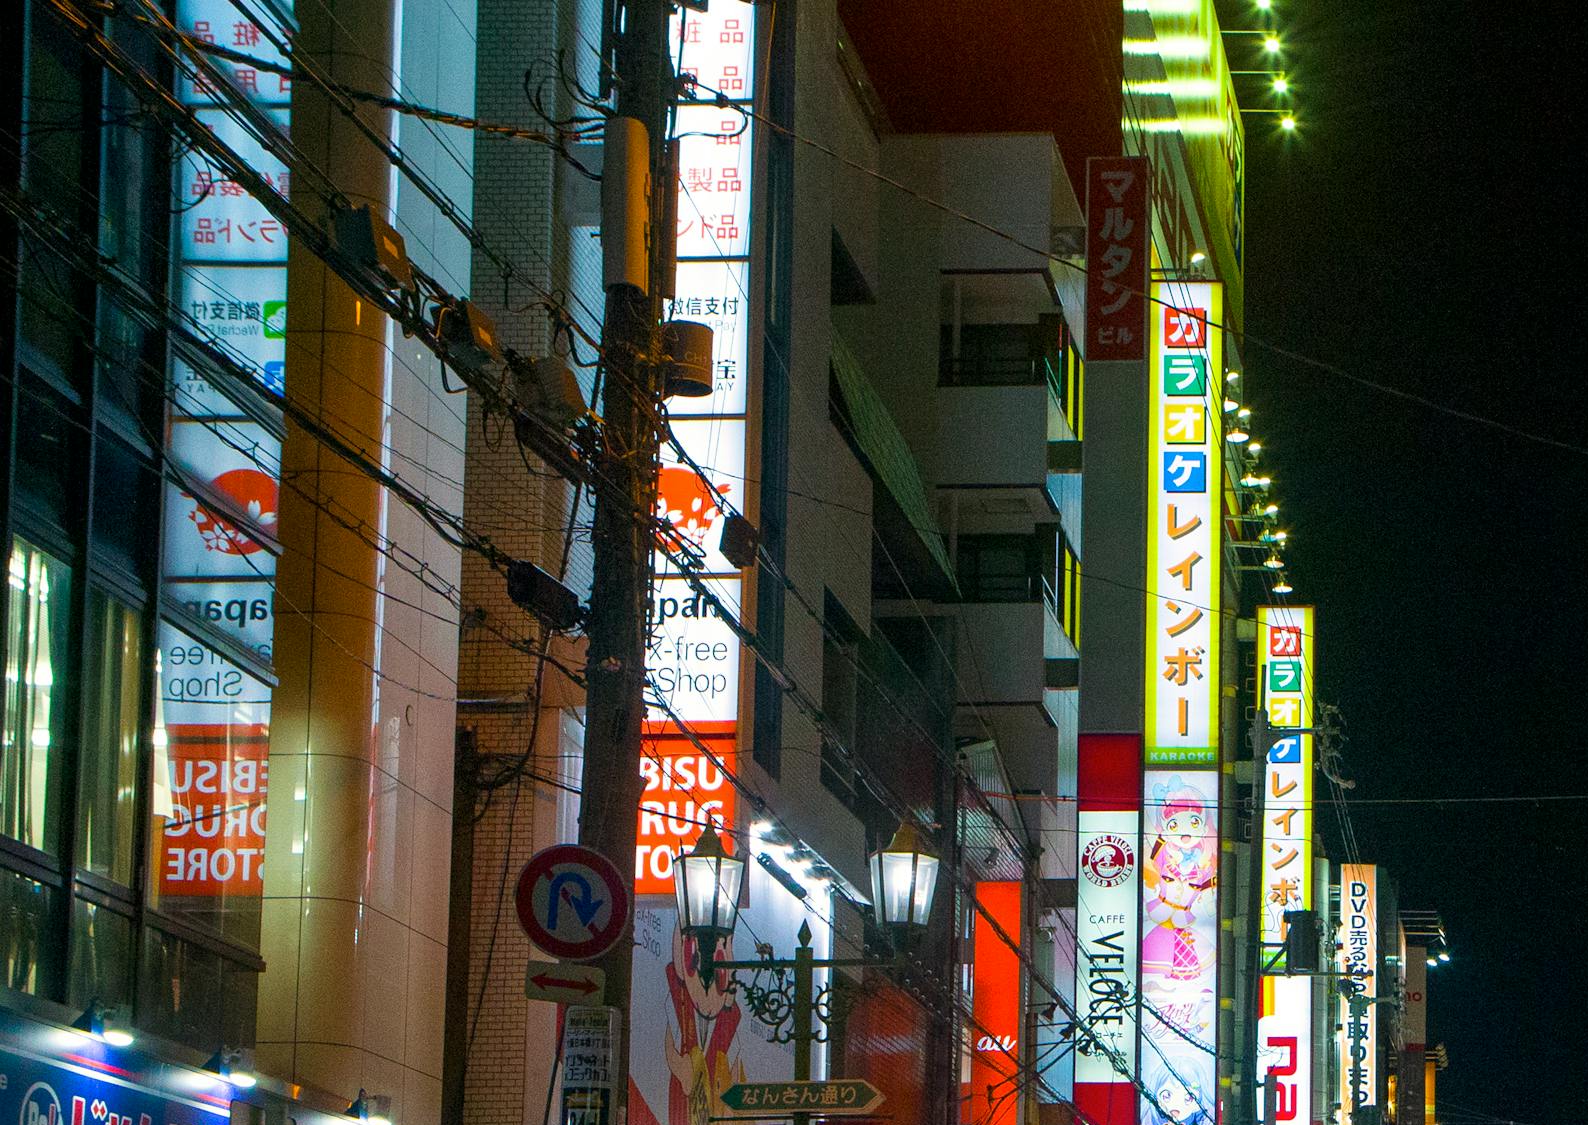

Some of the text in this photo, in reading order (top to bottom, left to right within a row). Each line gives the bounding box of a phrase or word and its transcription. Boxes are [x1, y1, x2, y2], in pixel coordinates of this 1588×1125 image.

[658, 666, 727, 700] Shop
[1149, 752, 1215, 762] KARAOKE
[977, 1034, 1016, 1052] au
[742, 1086, 857, 1104] なんさん通り
